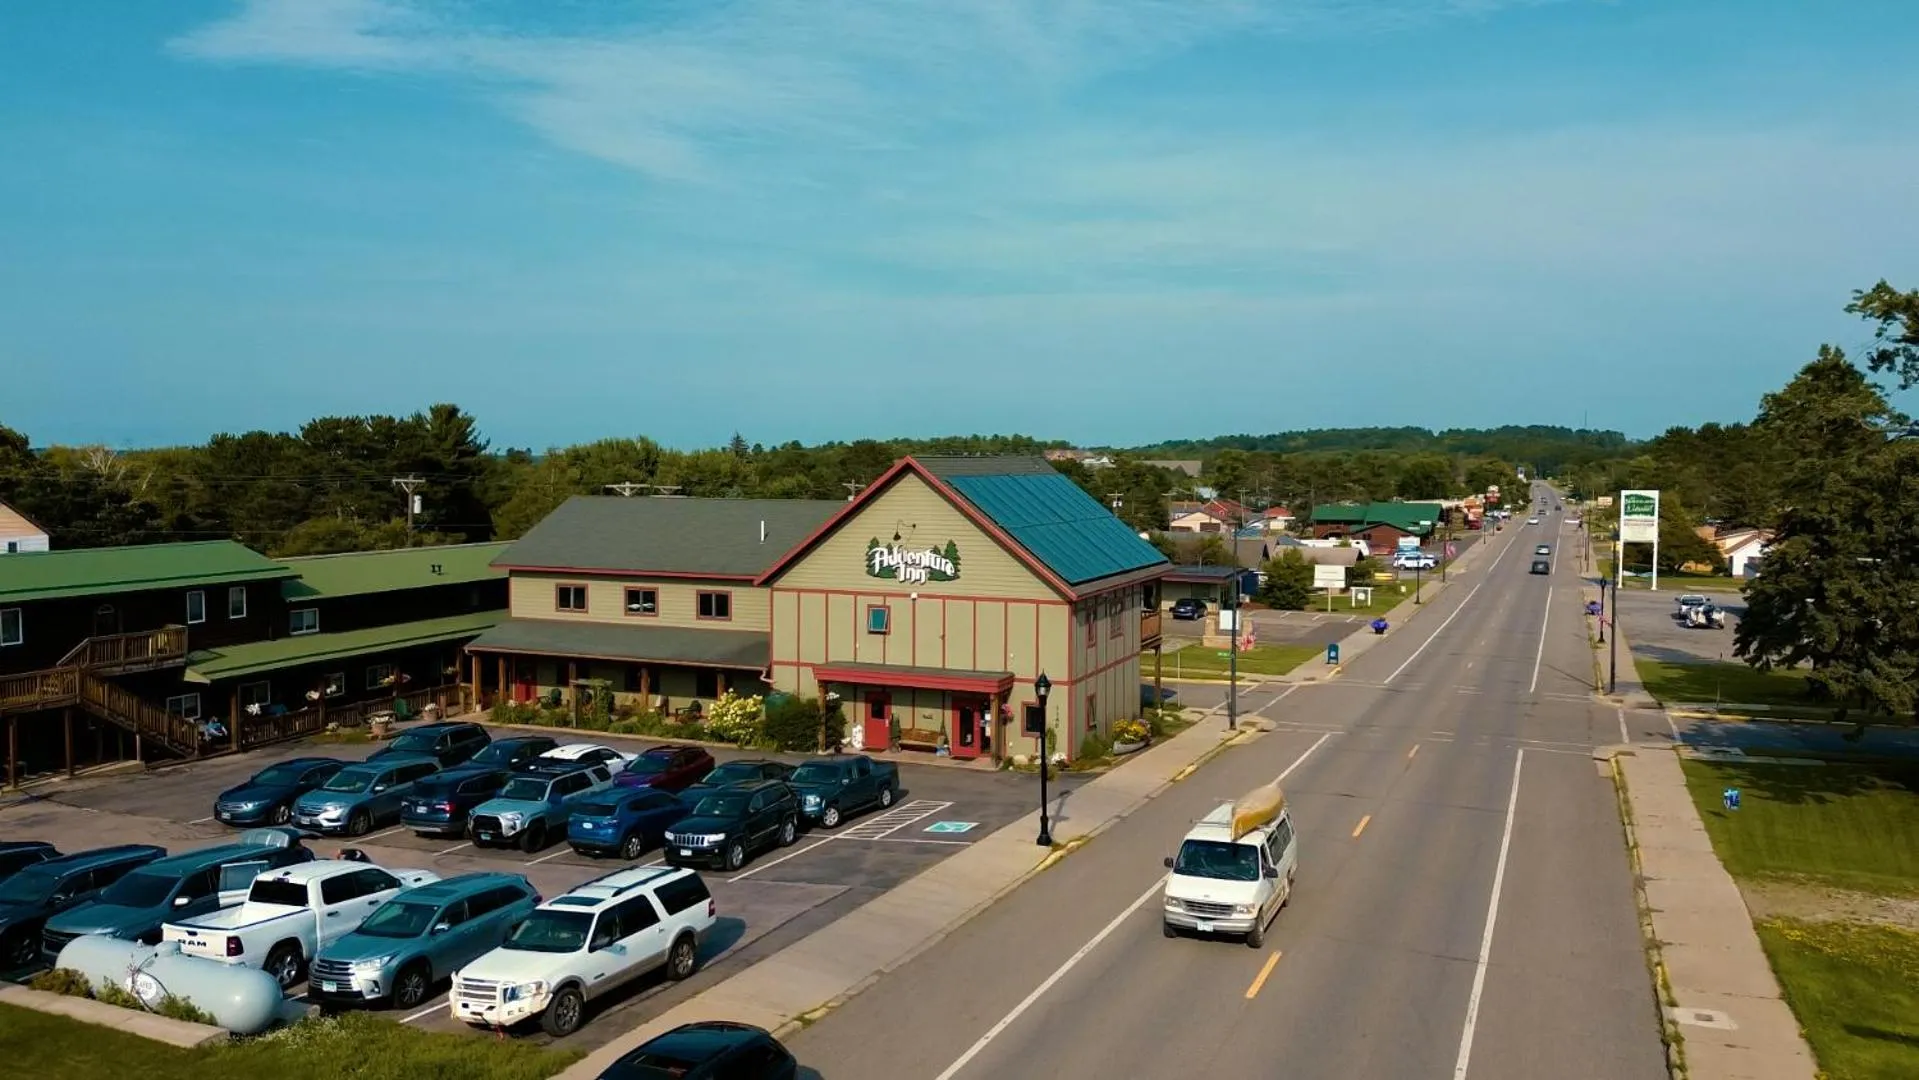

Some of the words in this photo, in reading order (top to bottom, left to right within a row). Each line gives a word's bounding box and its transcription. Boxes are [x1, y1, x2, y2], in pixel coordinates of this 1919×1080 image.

[868, 546, 955, 576] Adventure
[893, 563, 927, 583] Inn
[178, 938, 207, 948] RAM
